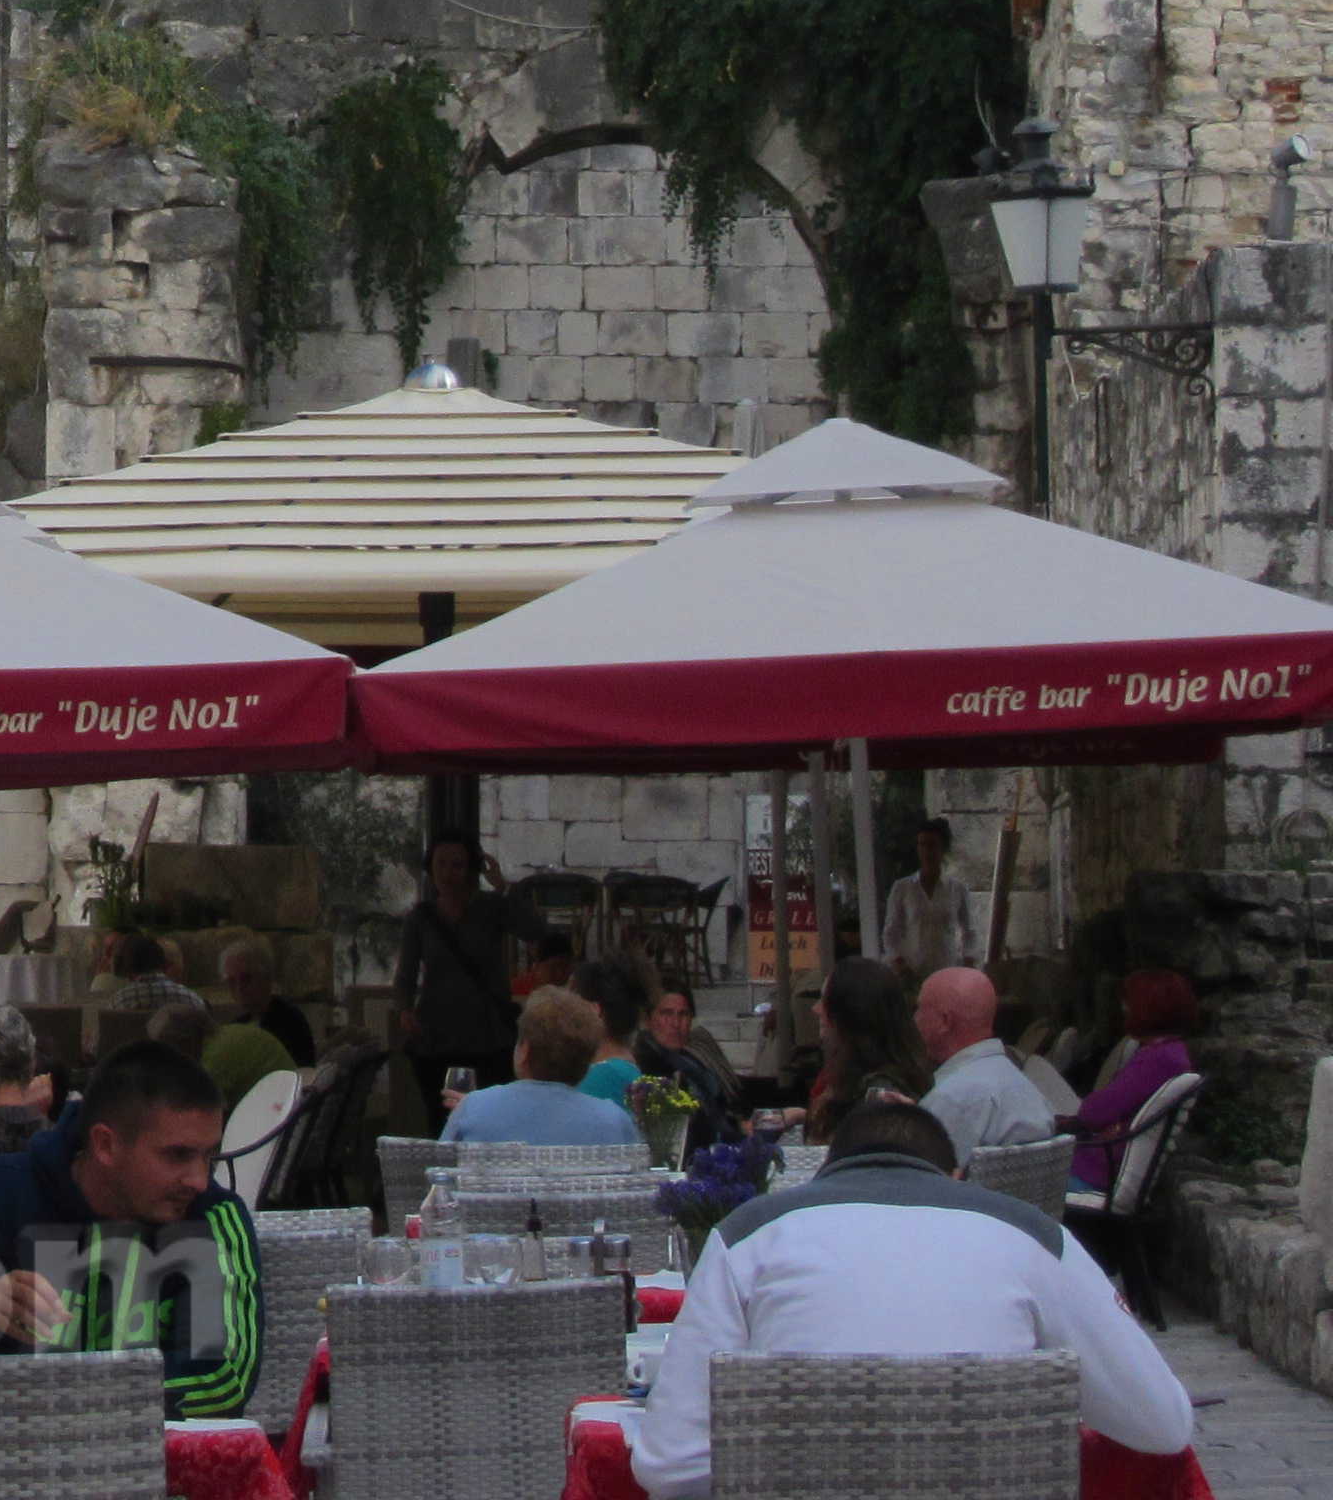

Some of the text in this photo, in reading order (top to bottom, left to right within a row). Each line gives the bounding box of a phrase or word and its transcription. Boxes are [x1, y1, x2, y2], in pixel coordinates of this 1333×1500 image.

[945, 664, 1313, 717] caffe bar "Duje No1"
[57, 696, 158, 741] "Duje
[168, 694, 261, 731] No1"
[754, 910, 815, 925] GRLL
